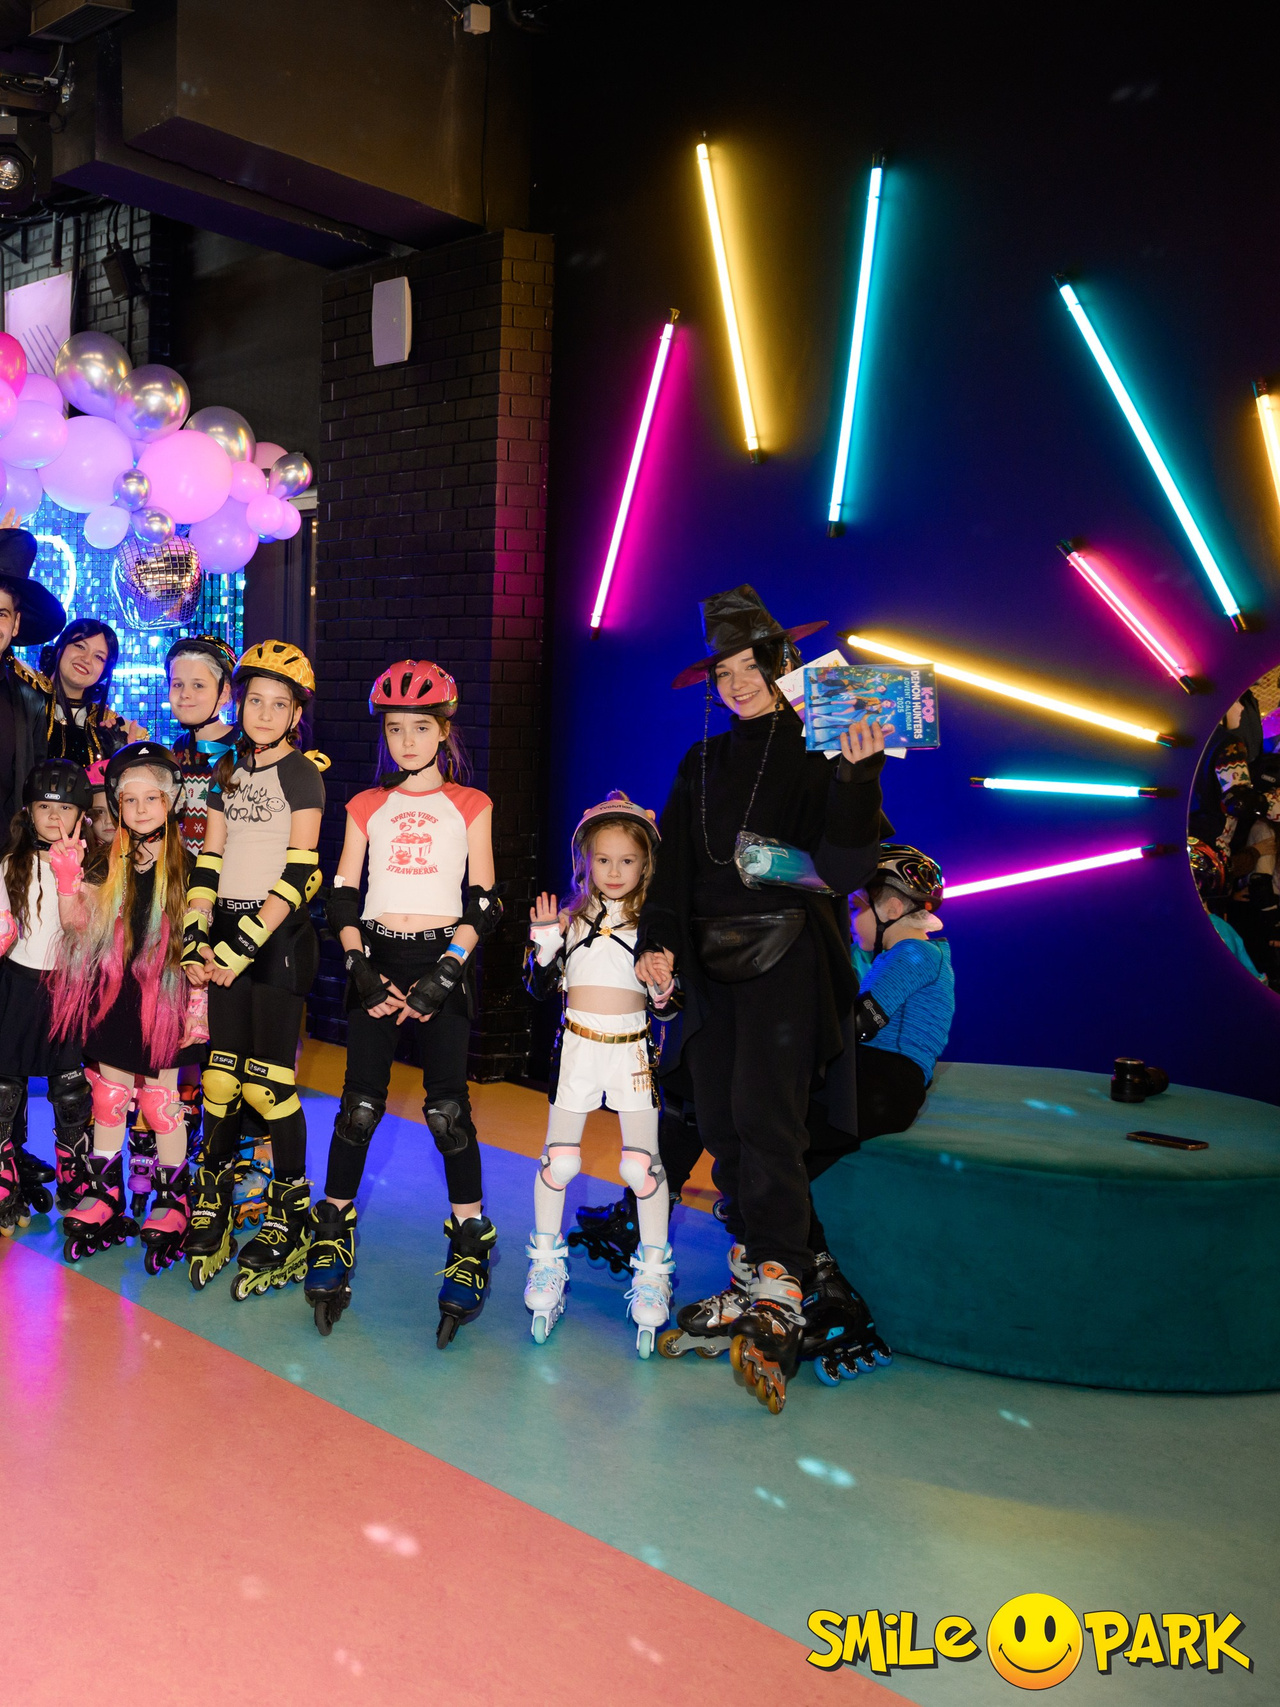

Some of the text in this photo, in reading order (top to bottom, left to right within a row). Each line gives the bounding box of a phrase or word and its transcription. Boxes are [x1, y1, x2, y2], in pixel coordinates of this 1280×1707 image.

[896, 697, 904, 713] 2025
[911, 670, 923, 739] DEMON HUNTERS
[921, 687, 934, 723] K-POP
[390, 811, 438, 824] SPRING VIBES
[386, 865, 438, 875] STRAWBERRY
[227, 899, 263, 911] Sport
[376, 924, 417, 940] GEAR
